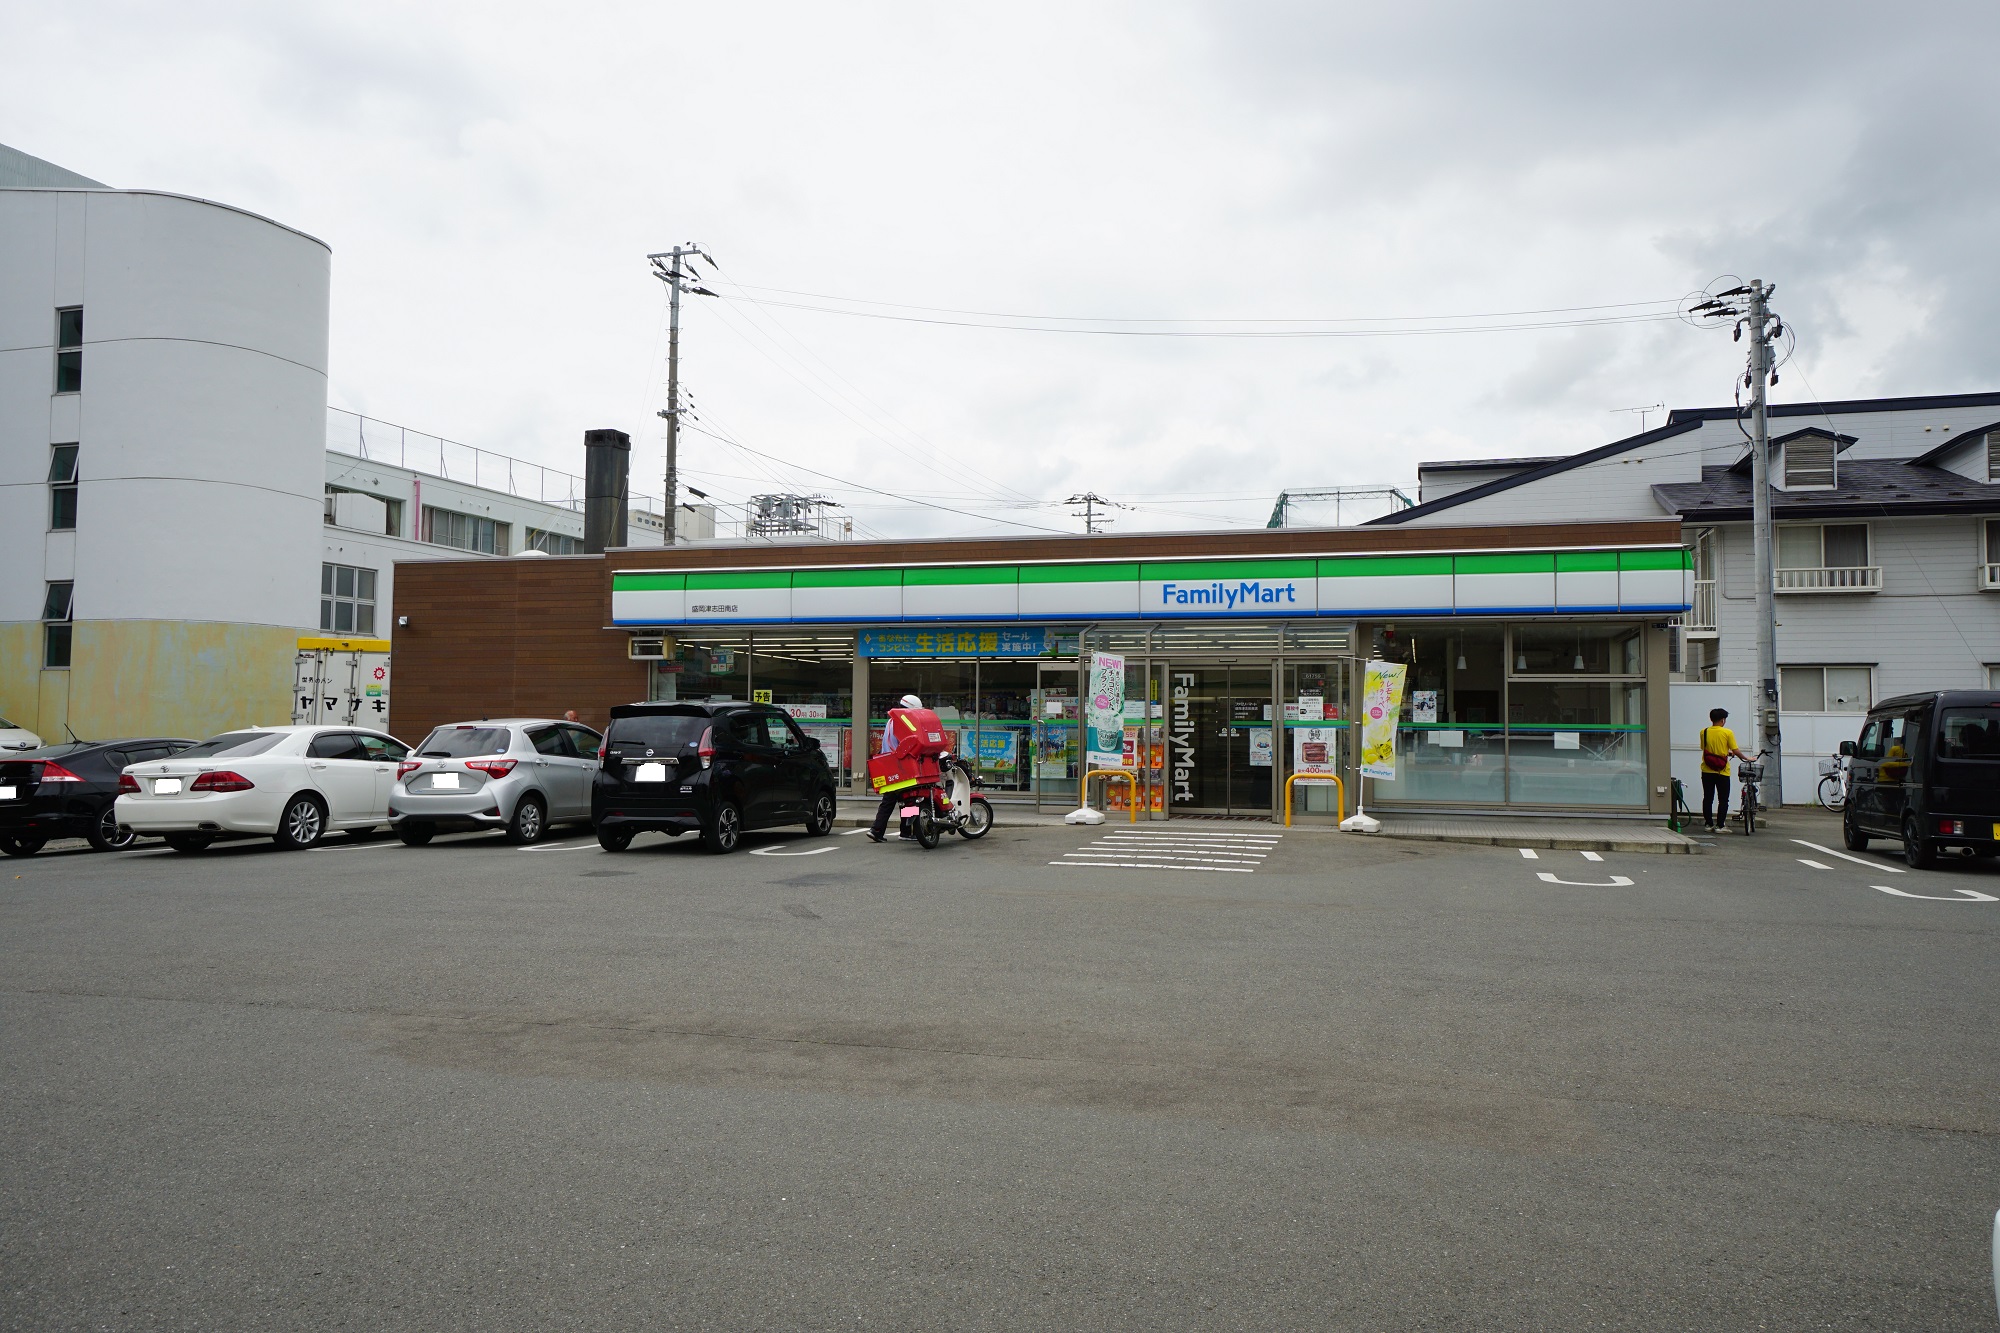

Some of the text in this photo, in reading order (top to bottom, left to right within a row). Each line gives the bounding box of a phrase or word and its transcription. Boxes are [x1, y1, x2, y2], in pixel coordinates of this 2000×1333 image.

[1163, 582, 1296, 609] FamilyMart
[915, 632, 998, 653] 生活応援
[1002, 631, 1030, 641] セール
[1001, 642, 1036, 652] 実施中!
[300, 696, 387, 713] ヤマザキ
[754, 691, 771, 703] 予告
[1169, 673, 1195, 801] FamilyMart
